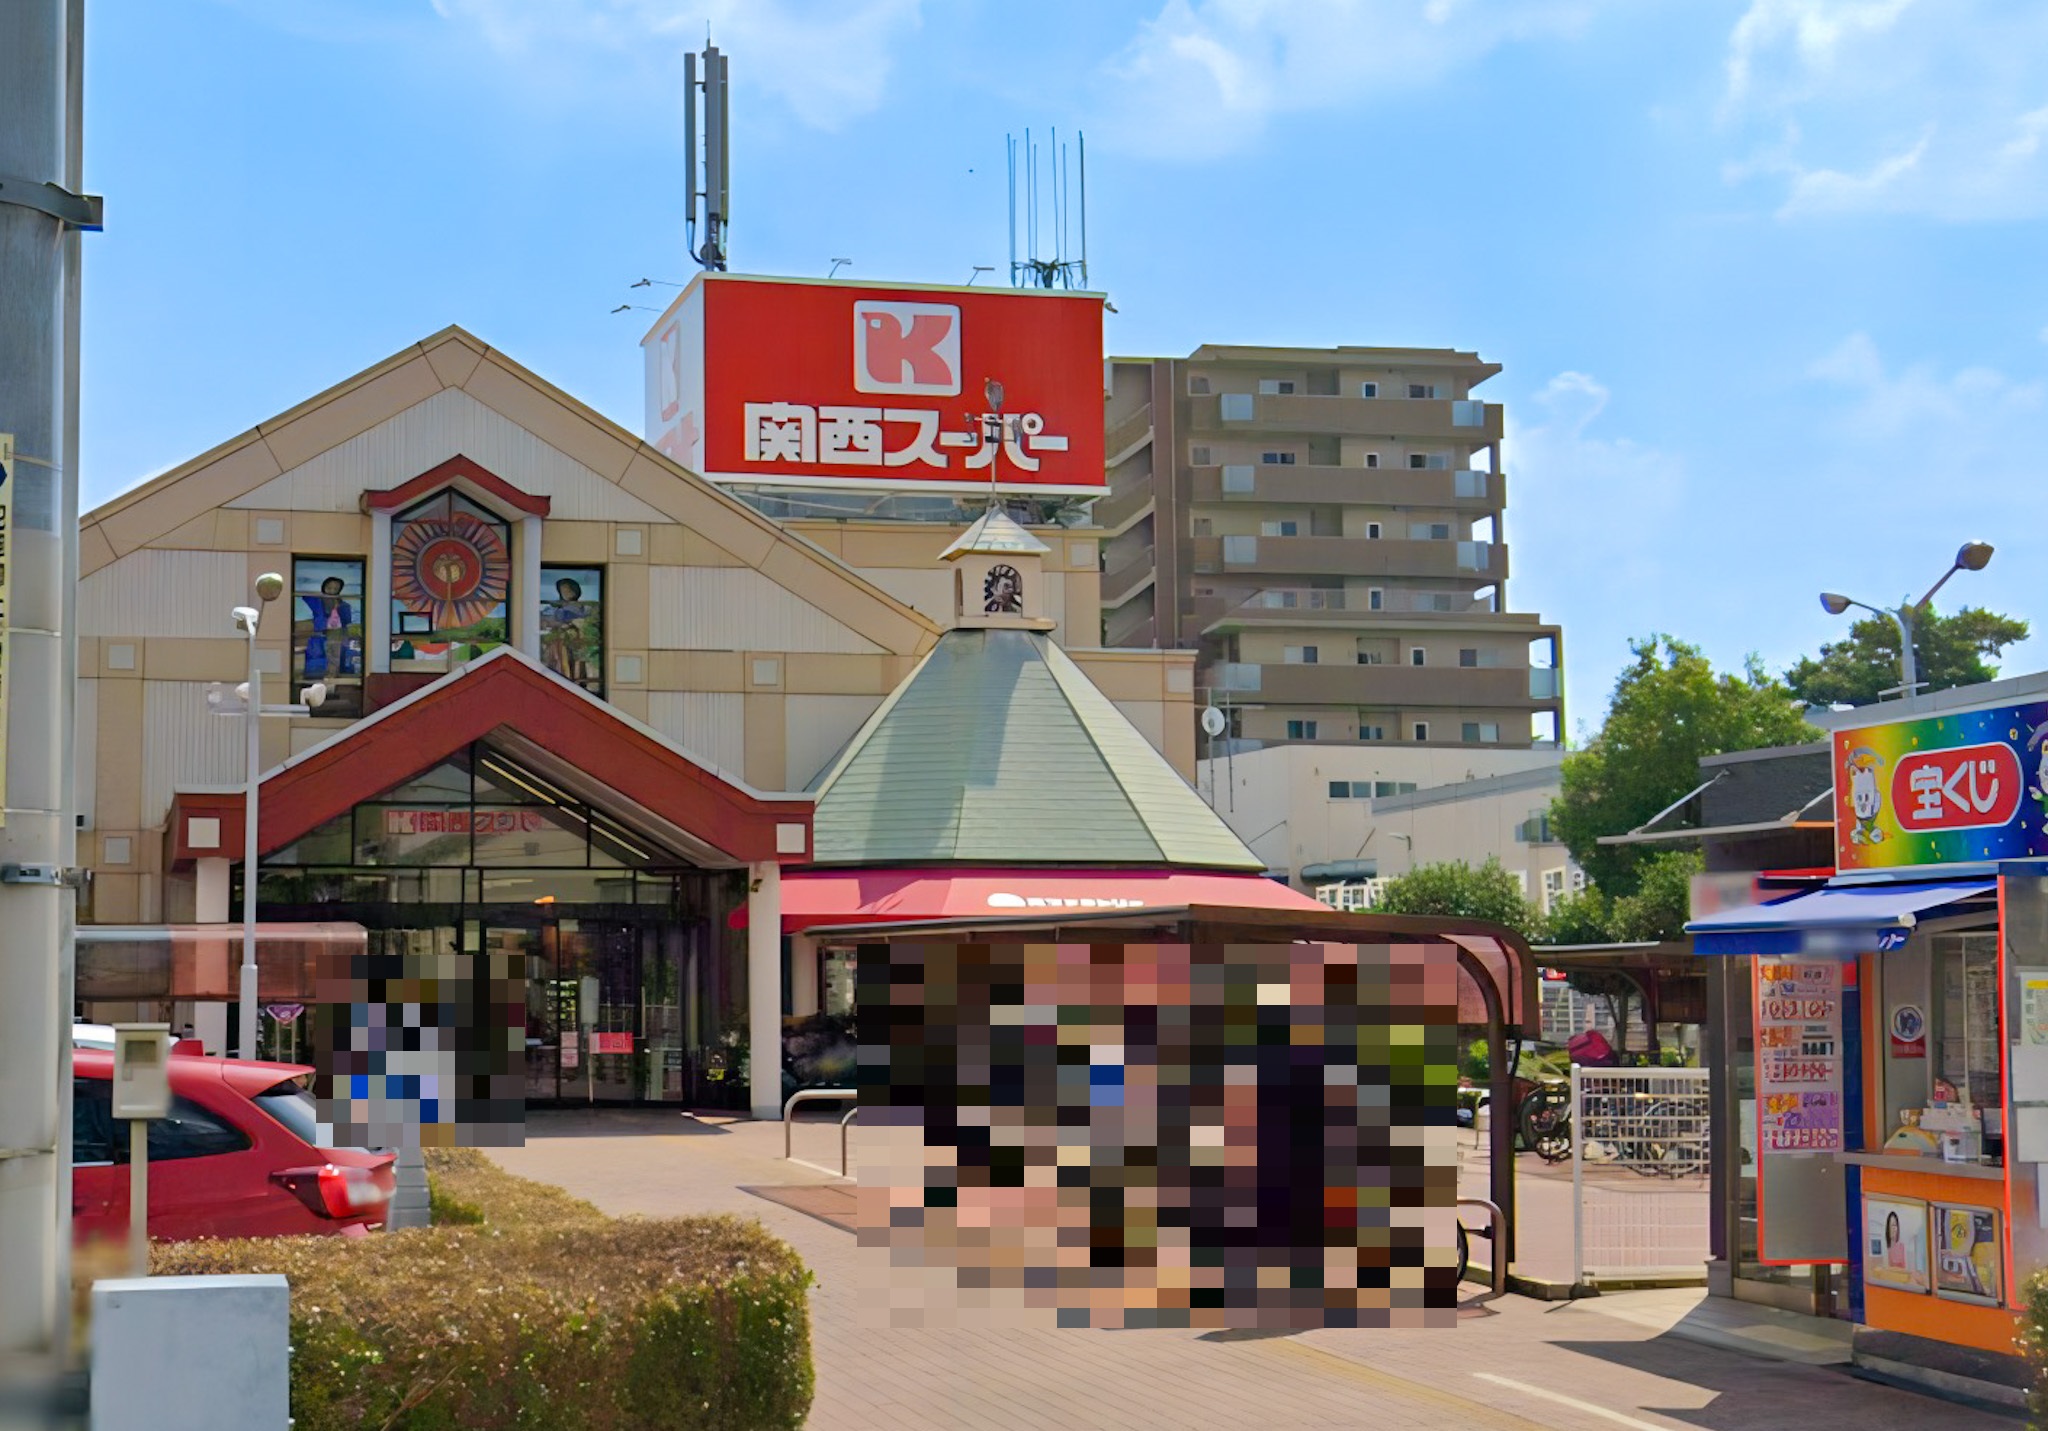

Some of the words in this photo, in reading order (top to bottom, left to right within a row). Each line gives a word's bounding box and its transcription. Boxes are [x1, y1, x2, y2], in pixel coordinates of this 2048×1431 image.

[744, 401, 1069, 472] 関西スーパー
[1909, 759, 2000, 820] 宝くじ
